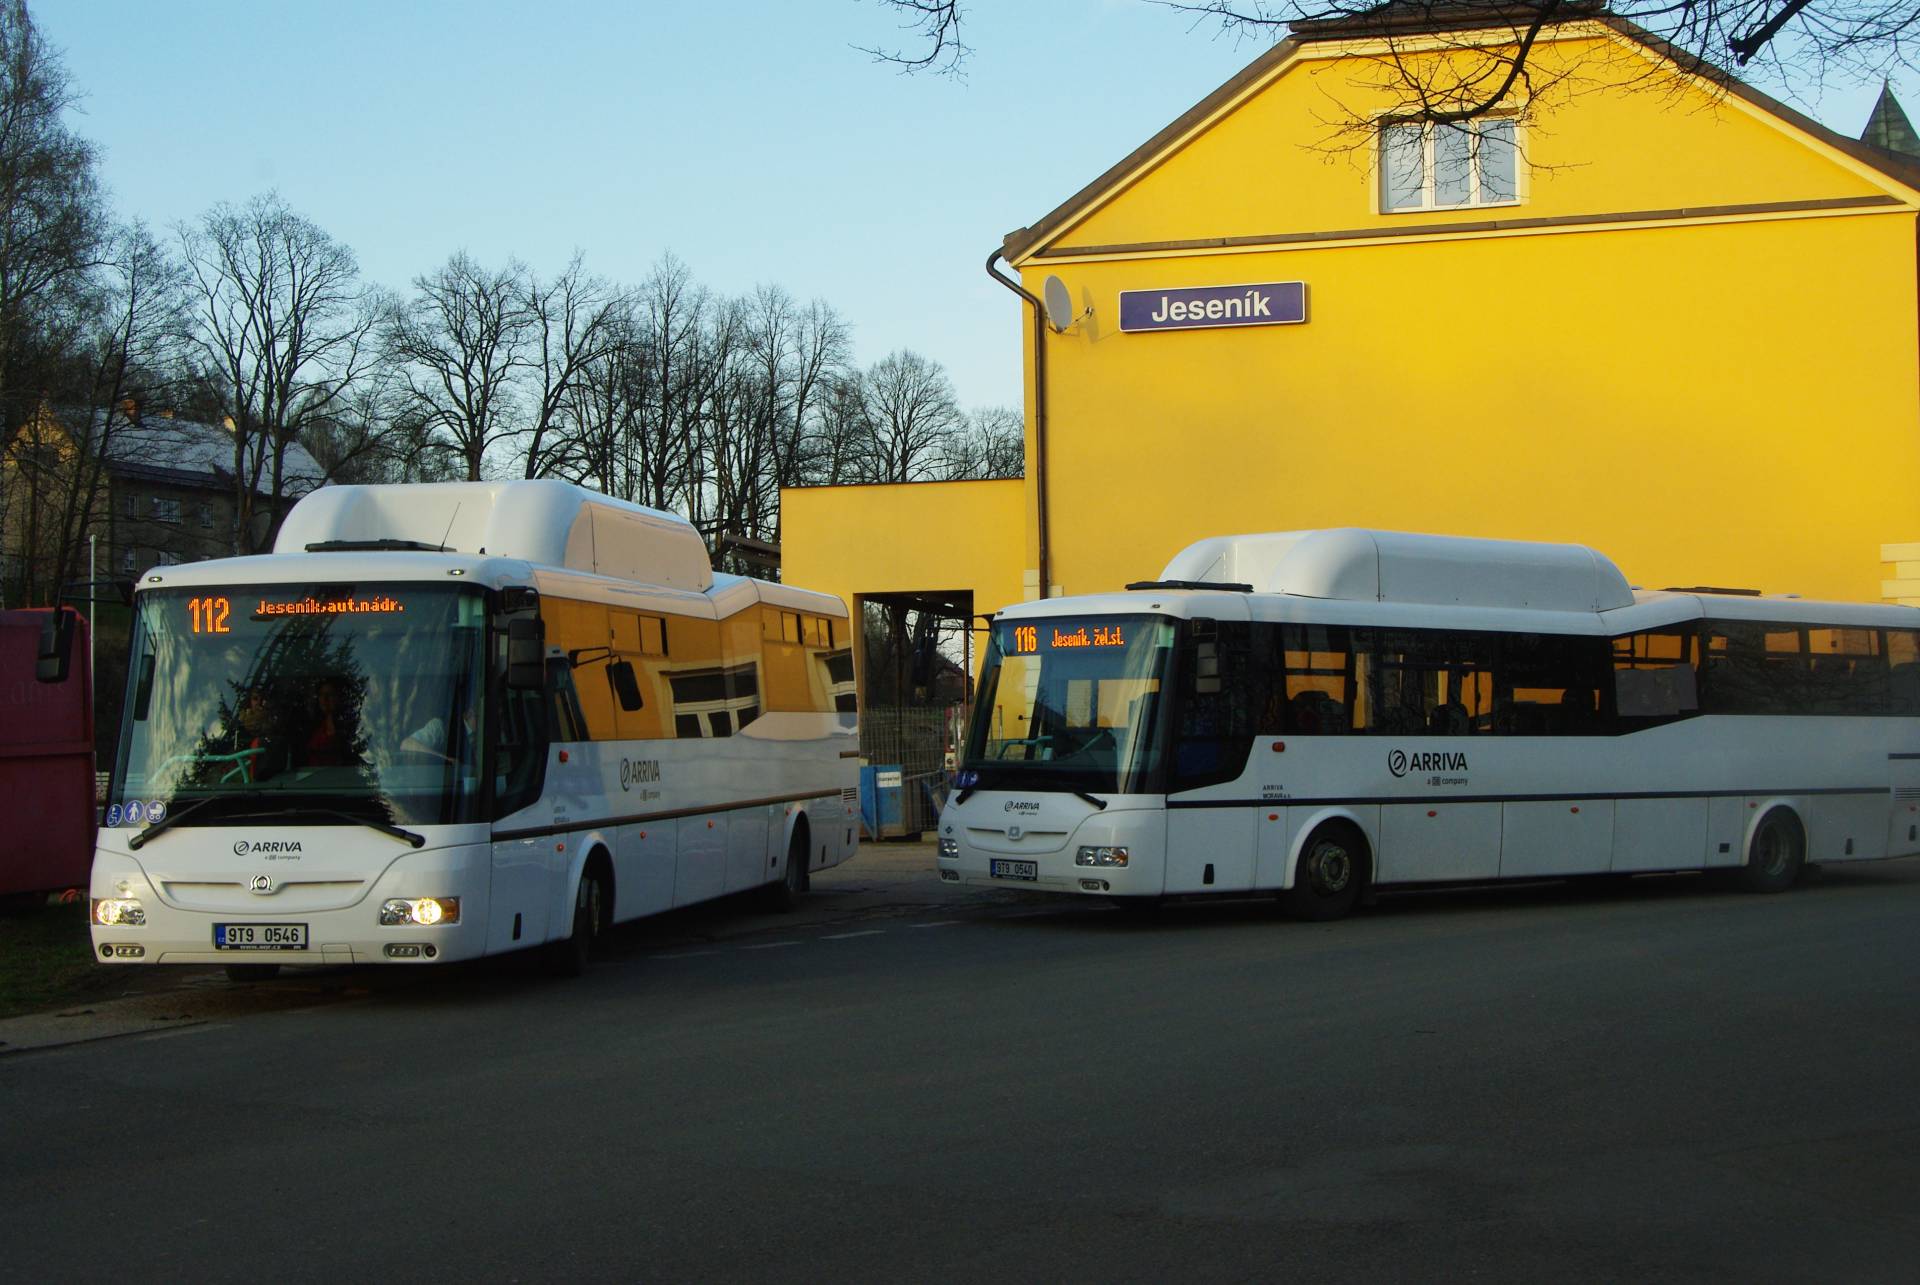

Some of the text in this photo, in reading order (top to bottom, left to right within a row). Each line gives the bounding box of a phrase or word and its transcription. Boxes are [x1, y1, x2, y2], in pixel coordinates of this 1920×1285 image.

[1152, 290, 1271, 322] Jeseník
[189, 597, 231, 632] 112
[1015, 627, 1037, 652] 116
[1409, 752, 1468, 771] ARRIVA
[631, 760, 660, 783] ARRIVA
[1442, 778, 1468, 786] company
[1013, 802, 1040, 810] ARRIVA
[251, 842, 302, 852] ARRIVA
[228, 927, 300, 943] 9T9 0546
